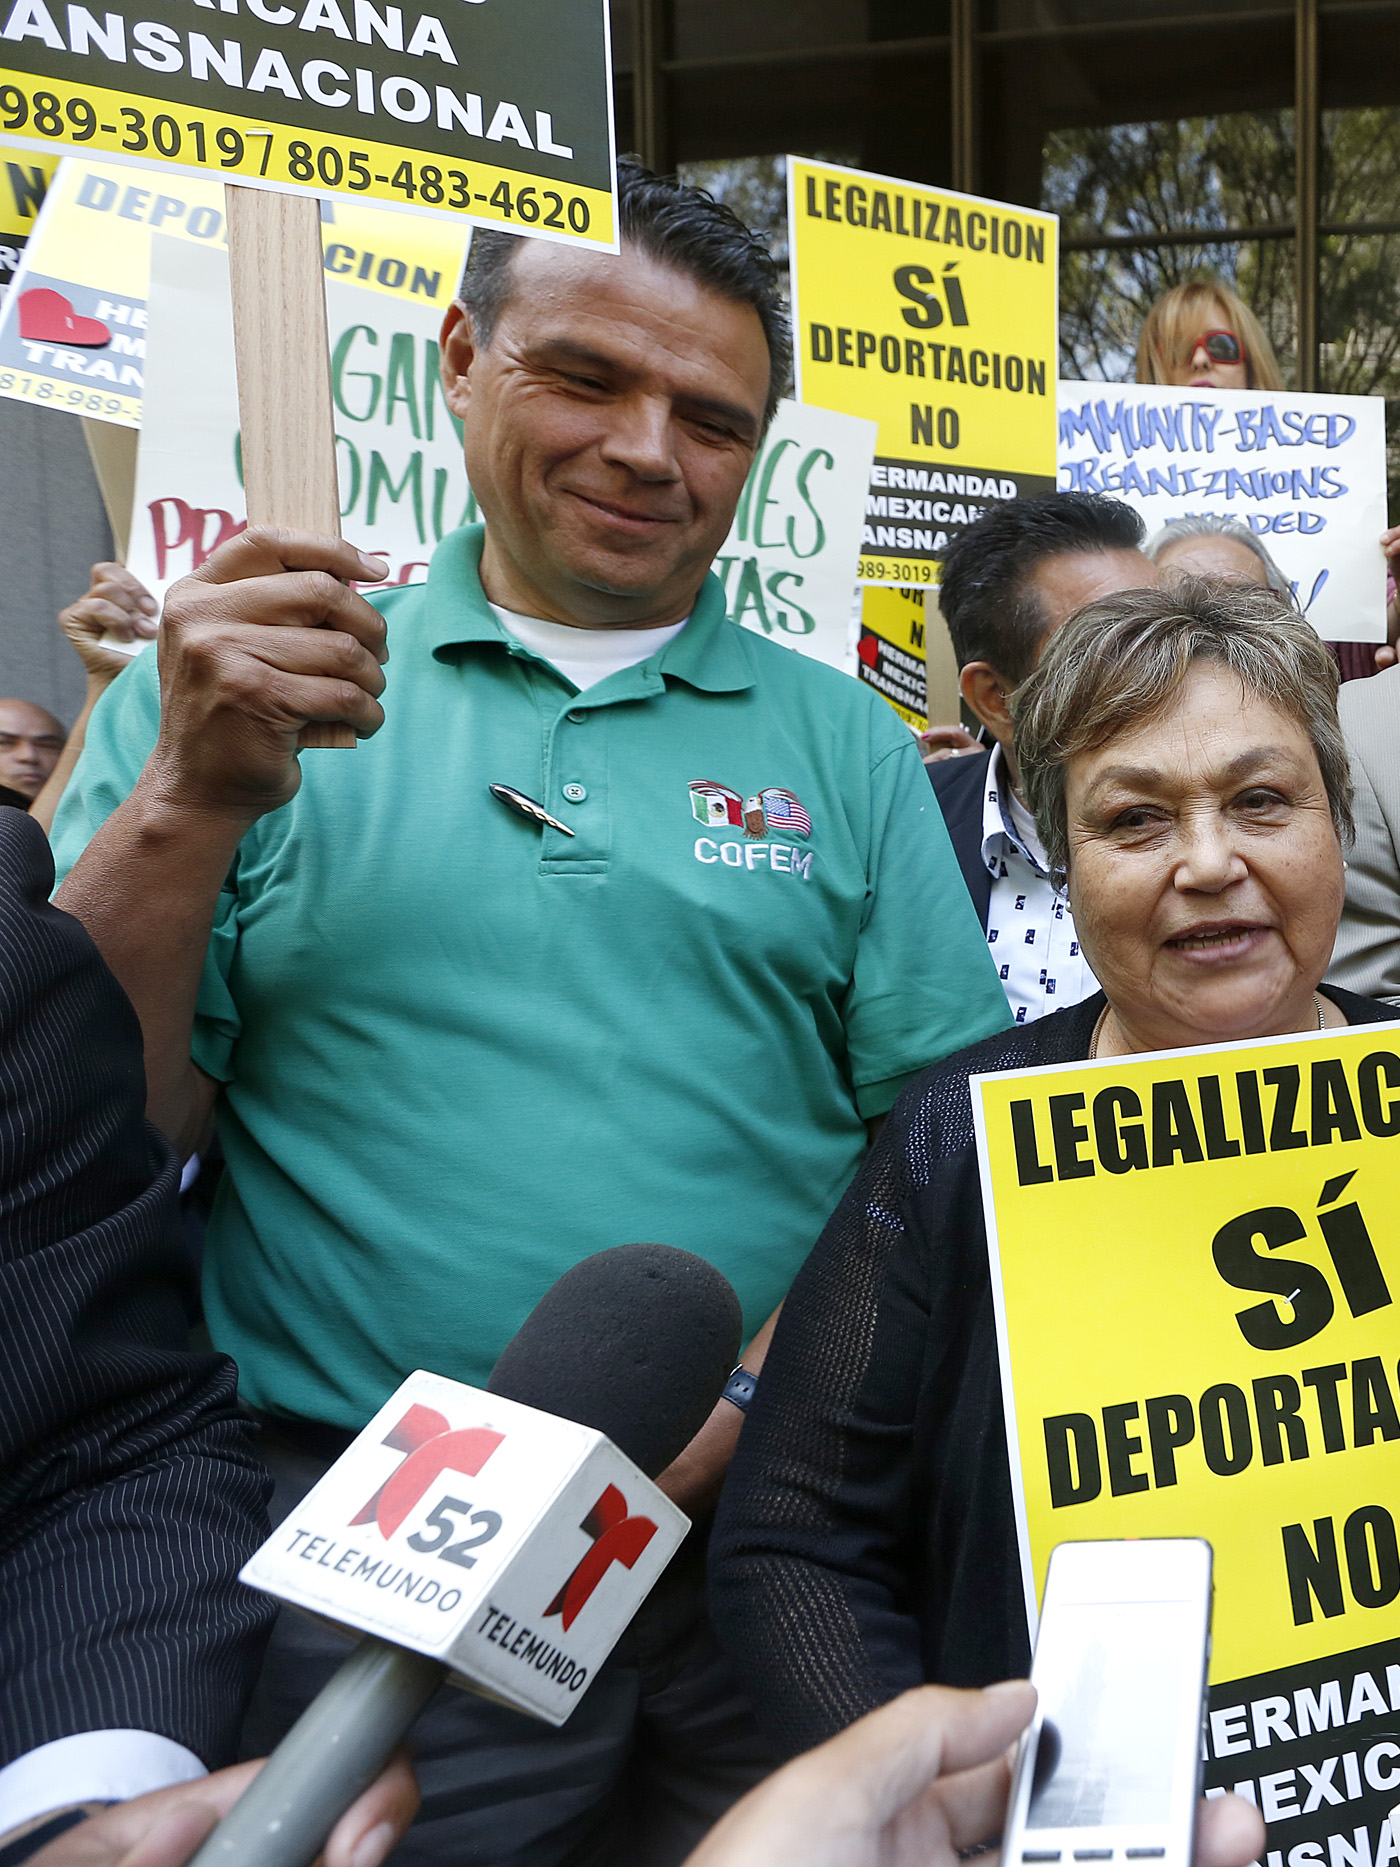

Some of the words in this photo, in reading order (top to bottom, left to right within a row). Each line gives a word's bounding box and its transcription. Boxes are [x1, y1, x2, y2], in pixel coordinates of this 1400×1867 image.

[194, 0, 459, 65] CANA
[0, 0, 574, 160] ANSNACIONAL
[0, 84, 244, 167] 989-3019
[287, 140, 591, 234] 805-483-4620
[805, 174, 1046, 265] LEGALIZACION
[892, 259, 970, 330] SÍ
[809, 321, 1046, 397] DEPORTACION
[910, 401, 960, 450] NO
[865, 494, 988, 526] MEXICAN
[869, 463, 1018, 501] ERMANDAD
[910, 618, 925, 649] N
[693, 837, 814, 880] COFEM
[1211, 1167, 1393, 1352] SÍ
[406, 1494, 503, 1570] 52
[282, 1528, 463, 1613] TELEMUNDO
[476, 1606, 589, 1693] TELEMUNDO
